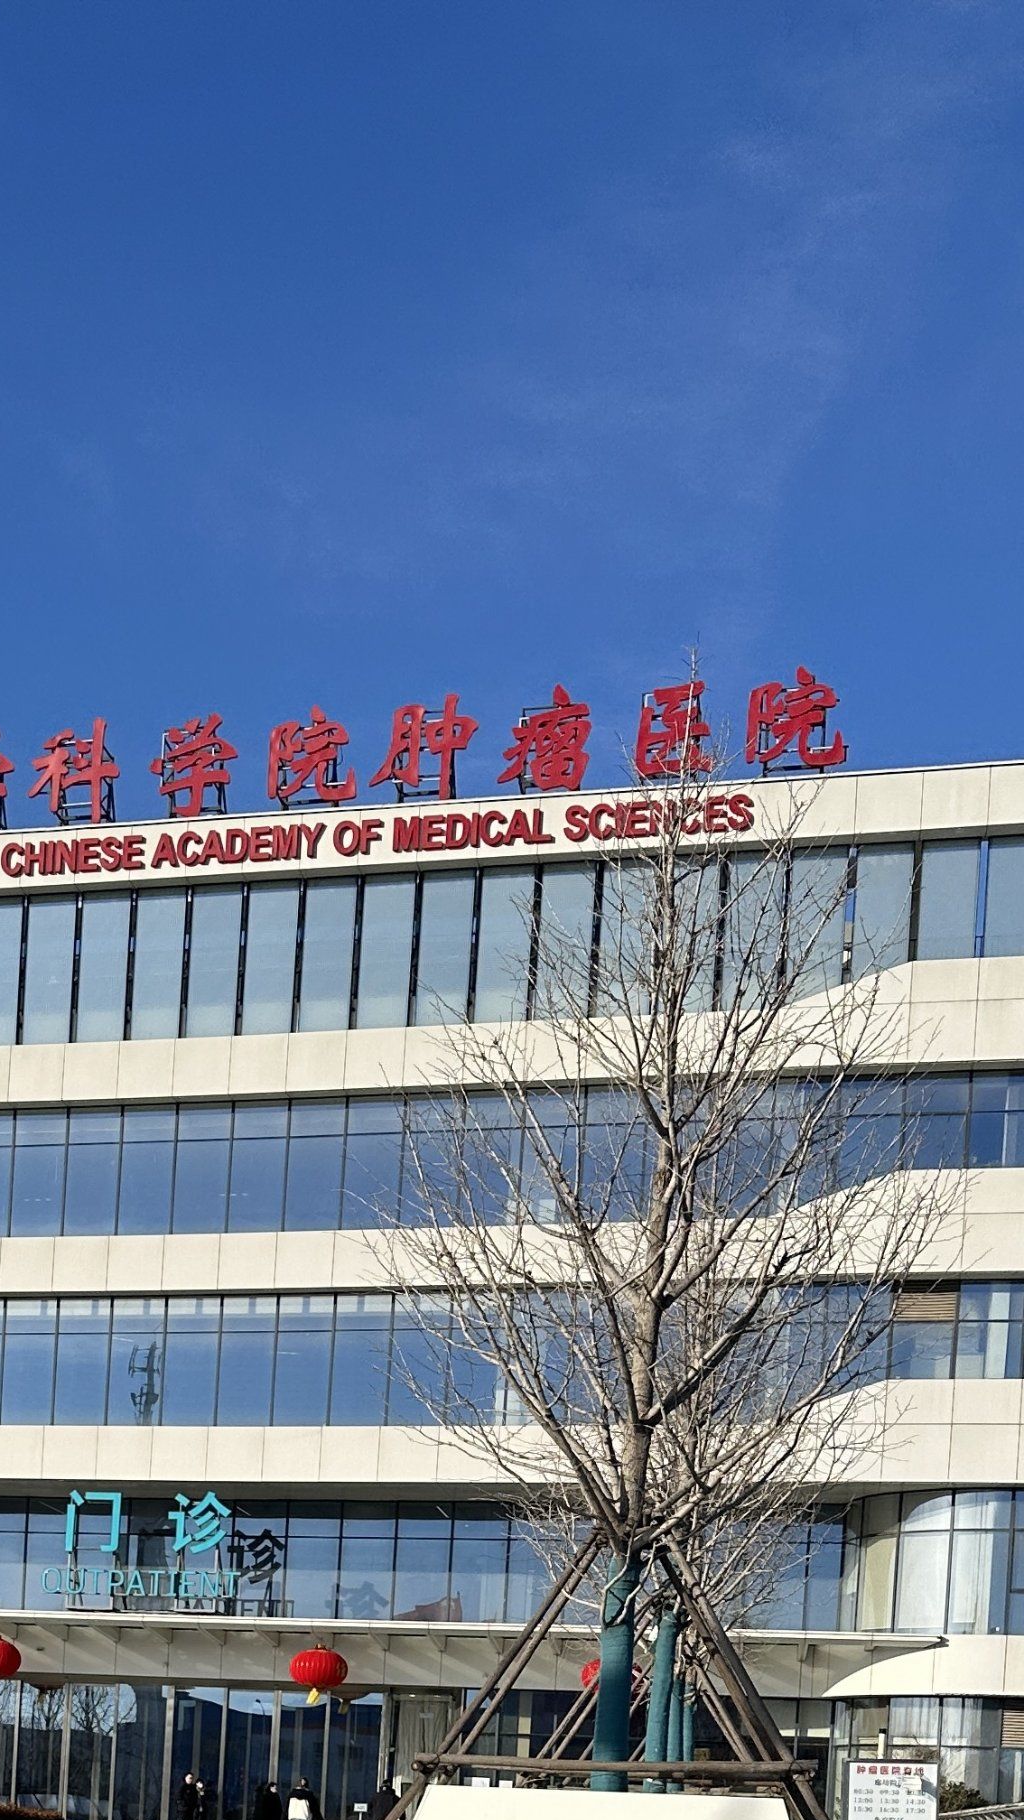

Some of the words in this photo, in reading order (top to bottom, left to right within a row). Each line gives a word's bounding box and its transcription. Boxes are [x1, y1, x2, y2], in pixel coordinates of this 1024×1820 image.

[1, 835, 143, 878] CHINESE
[151, 822, 326, 868] ACADEMY
[333, 819, 383, 857] OF
[392, 809, 554, 852] MEDICAL
[563, 794, 755, 842] SCIENCES
[65, 1490, 232, 1554] 门诊
[41, 1567, 241, 1599] OUTPATIENT
